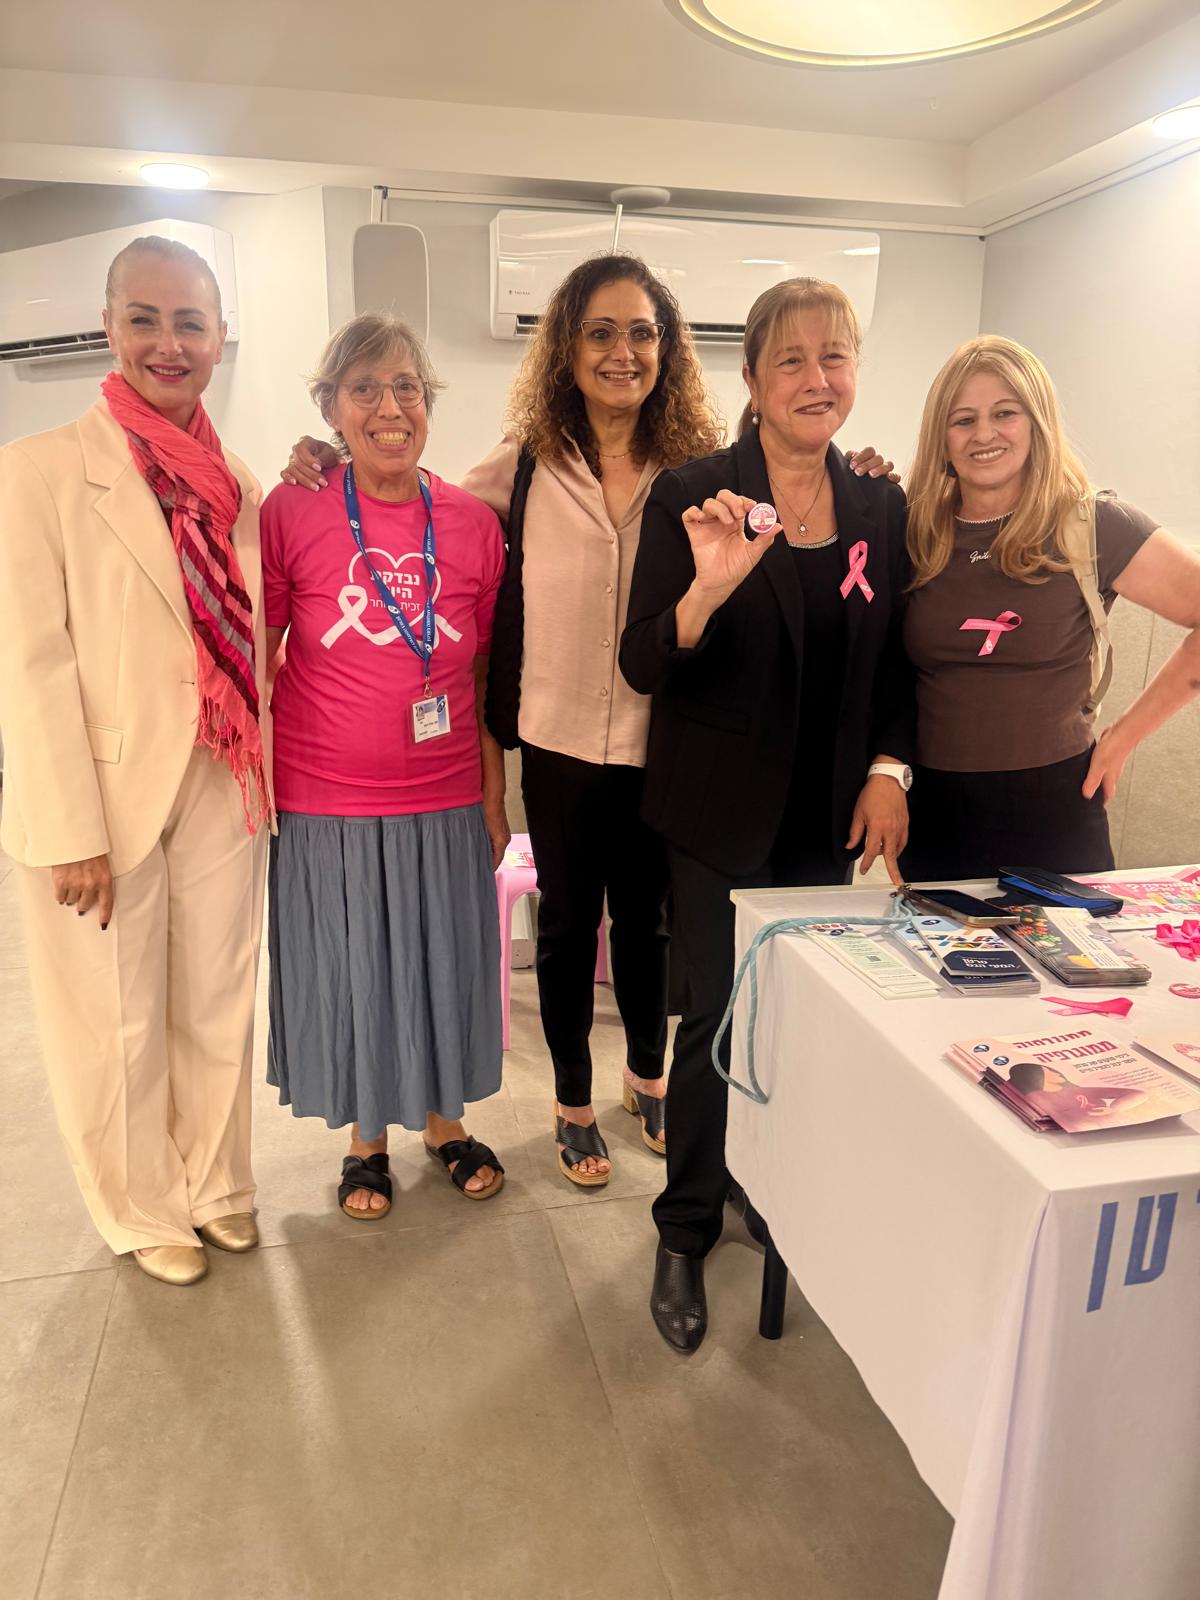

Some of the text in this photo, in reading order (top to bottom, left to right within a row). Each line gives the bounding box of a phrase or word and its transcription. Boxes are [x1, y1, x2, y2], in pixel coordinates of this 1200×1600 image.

[386, 586, 412, 599] היו
[400, 601, 421, 611] זכית
[1032, 1040, 1119, 1063] ממוגרפיה
[1086, 1188, 1200, 1313] טן
